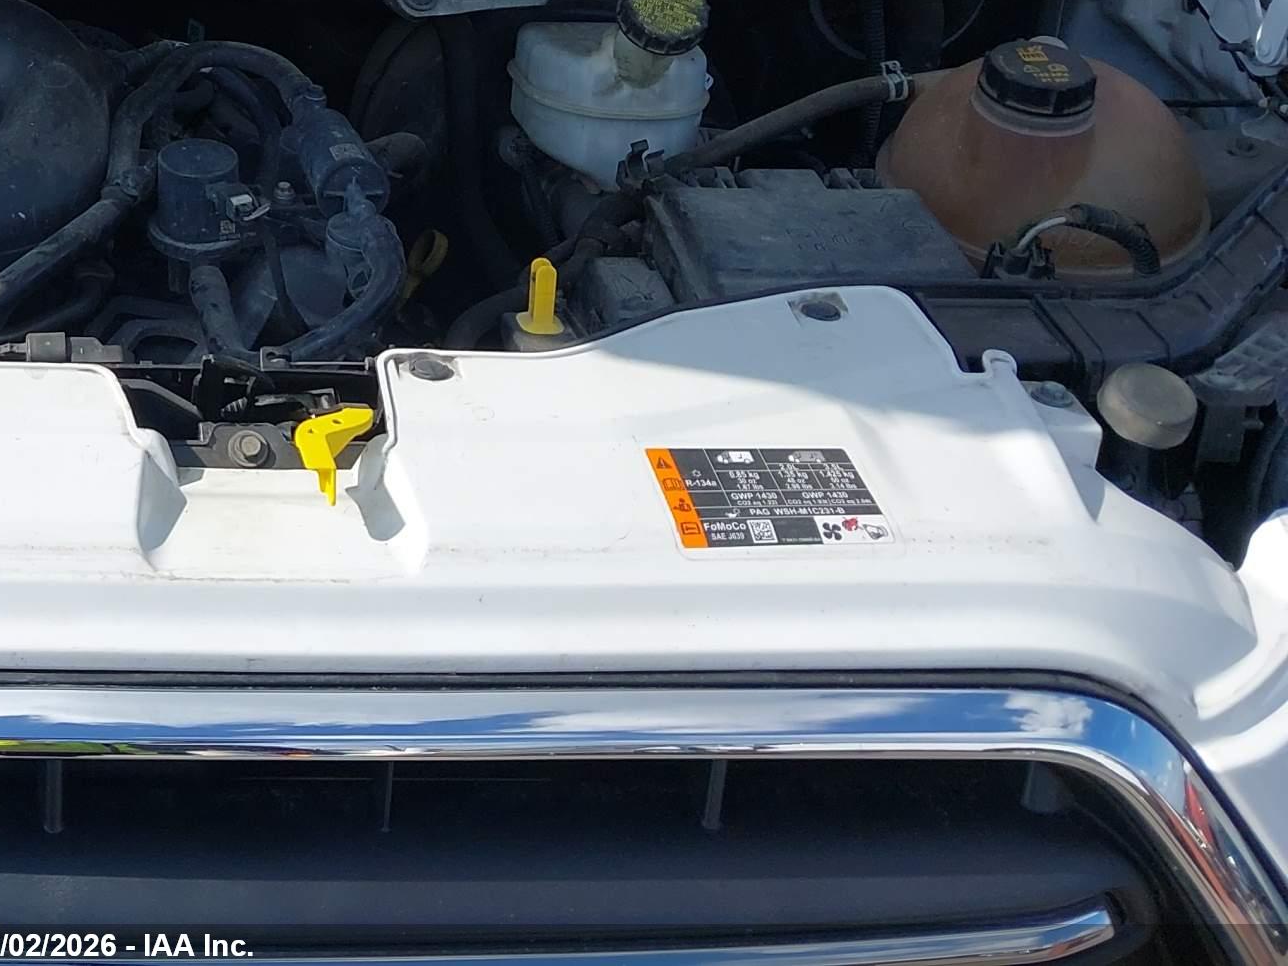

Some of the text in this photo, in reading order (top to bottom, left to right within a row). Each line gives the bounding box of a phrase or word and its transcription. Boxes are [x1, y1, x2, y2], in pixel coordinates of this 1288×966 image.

[748, 471, 760, 480] kg
[796, 471, 809, 479] kg
[842, 471, 854, 479] kg
[685, 479, 717, 488] R-134a
[731, 492, 777, 500] GWP 1430
[749, 507, 846, 516] PAG WSH-M1C231-B
[704, 522, 747, 531] FoMoCo
